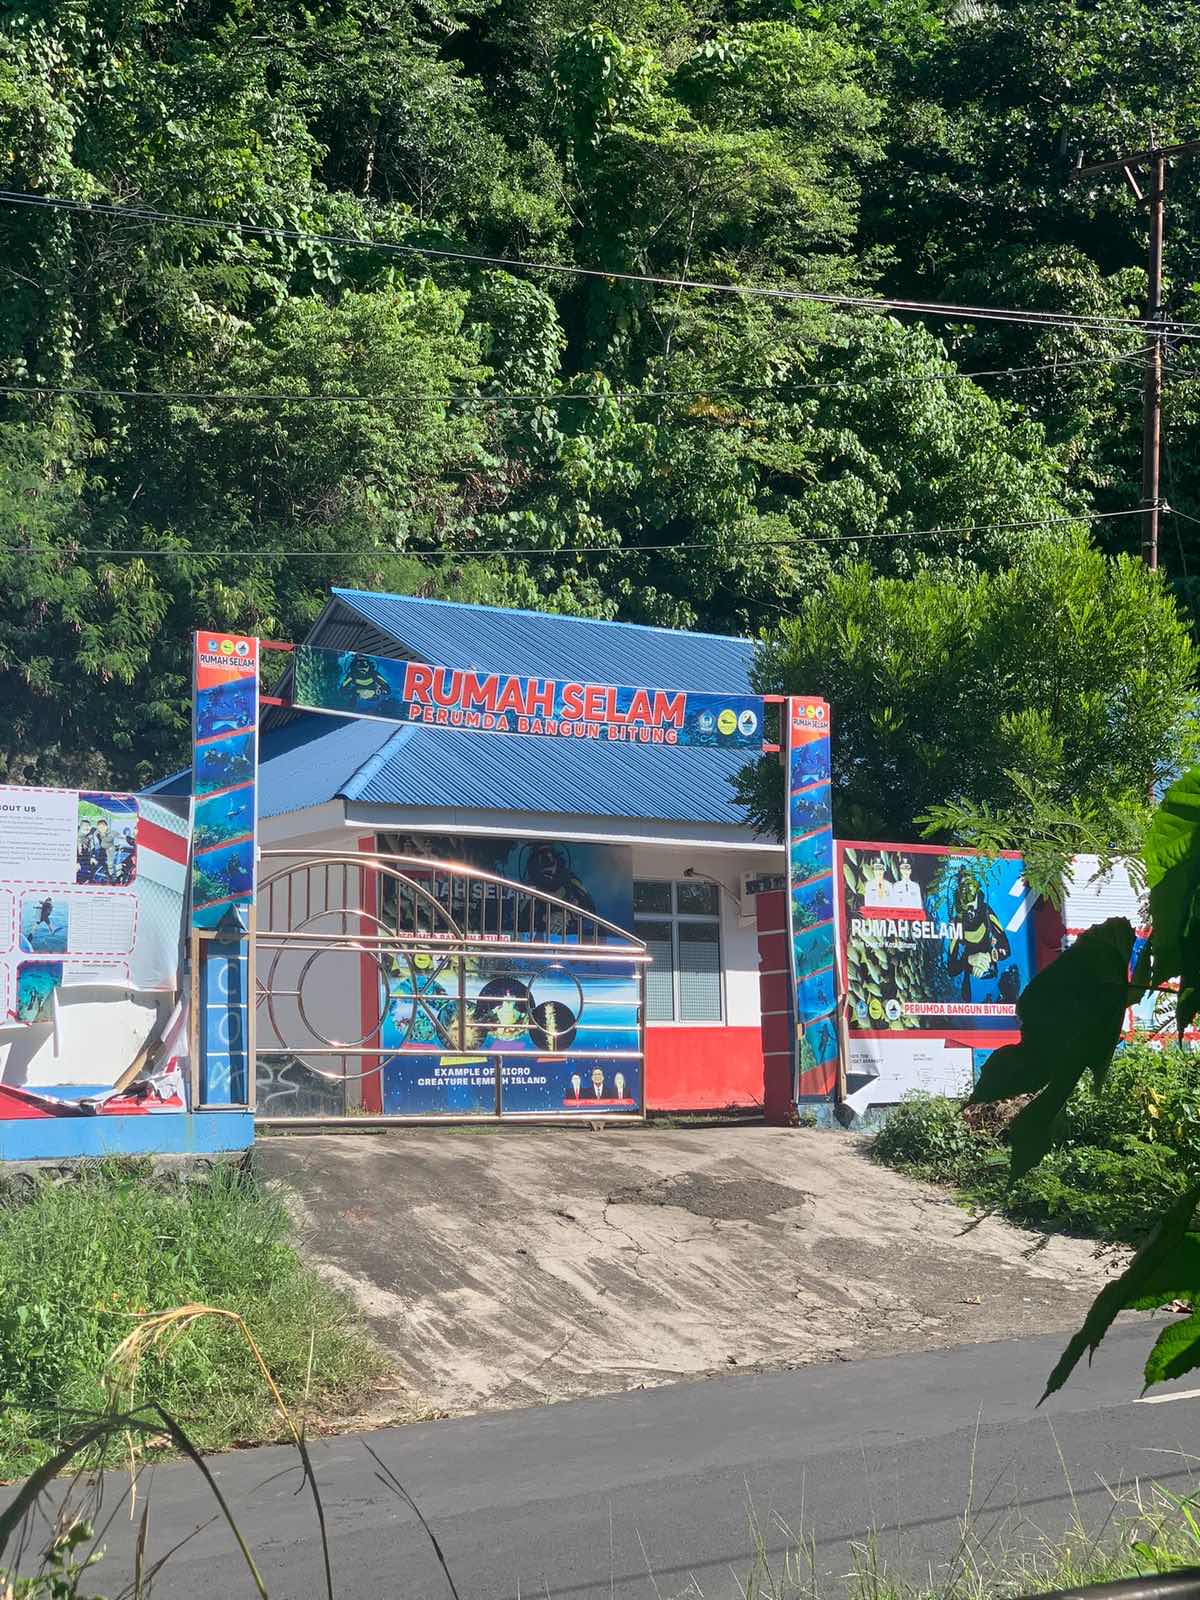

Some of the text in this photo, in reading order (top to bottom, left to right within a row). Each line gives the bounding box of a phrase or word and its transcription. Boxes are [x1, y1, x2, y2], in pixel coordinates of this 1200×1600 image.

[200, 654, 255, 667] RUMAH SELAM
[403, 661, 687, 728] RUMAH SELAM
[409, 704, 678, 744] PERUMDA BANGUN BITUNG
[0, 804, 37, 813] OUT US
[851, 918, 963, 940] RUMAH SELAM
[905, 1003, 1015, 1015] PERUMDA BANGUN BITUNG
[434, 1068, 480, 1076] EXAMPLE
[482, 1067, 496, 1075] OF
[417, 1077, 468, 1086] CREATURE
[511, 1076, 547, 1084] ISLAND
